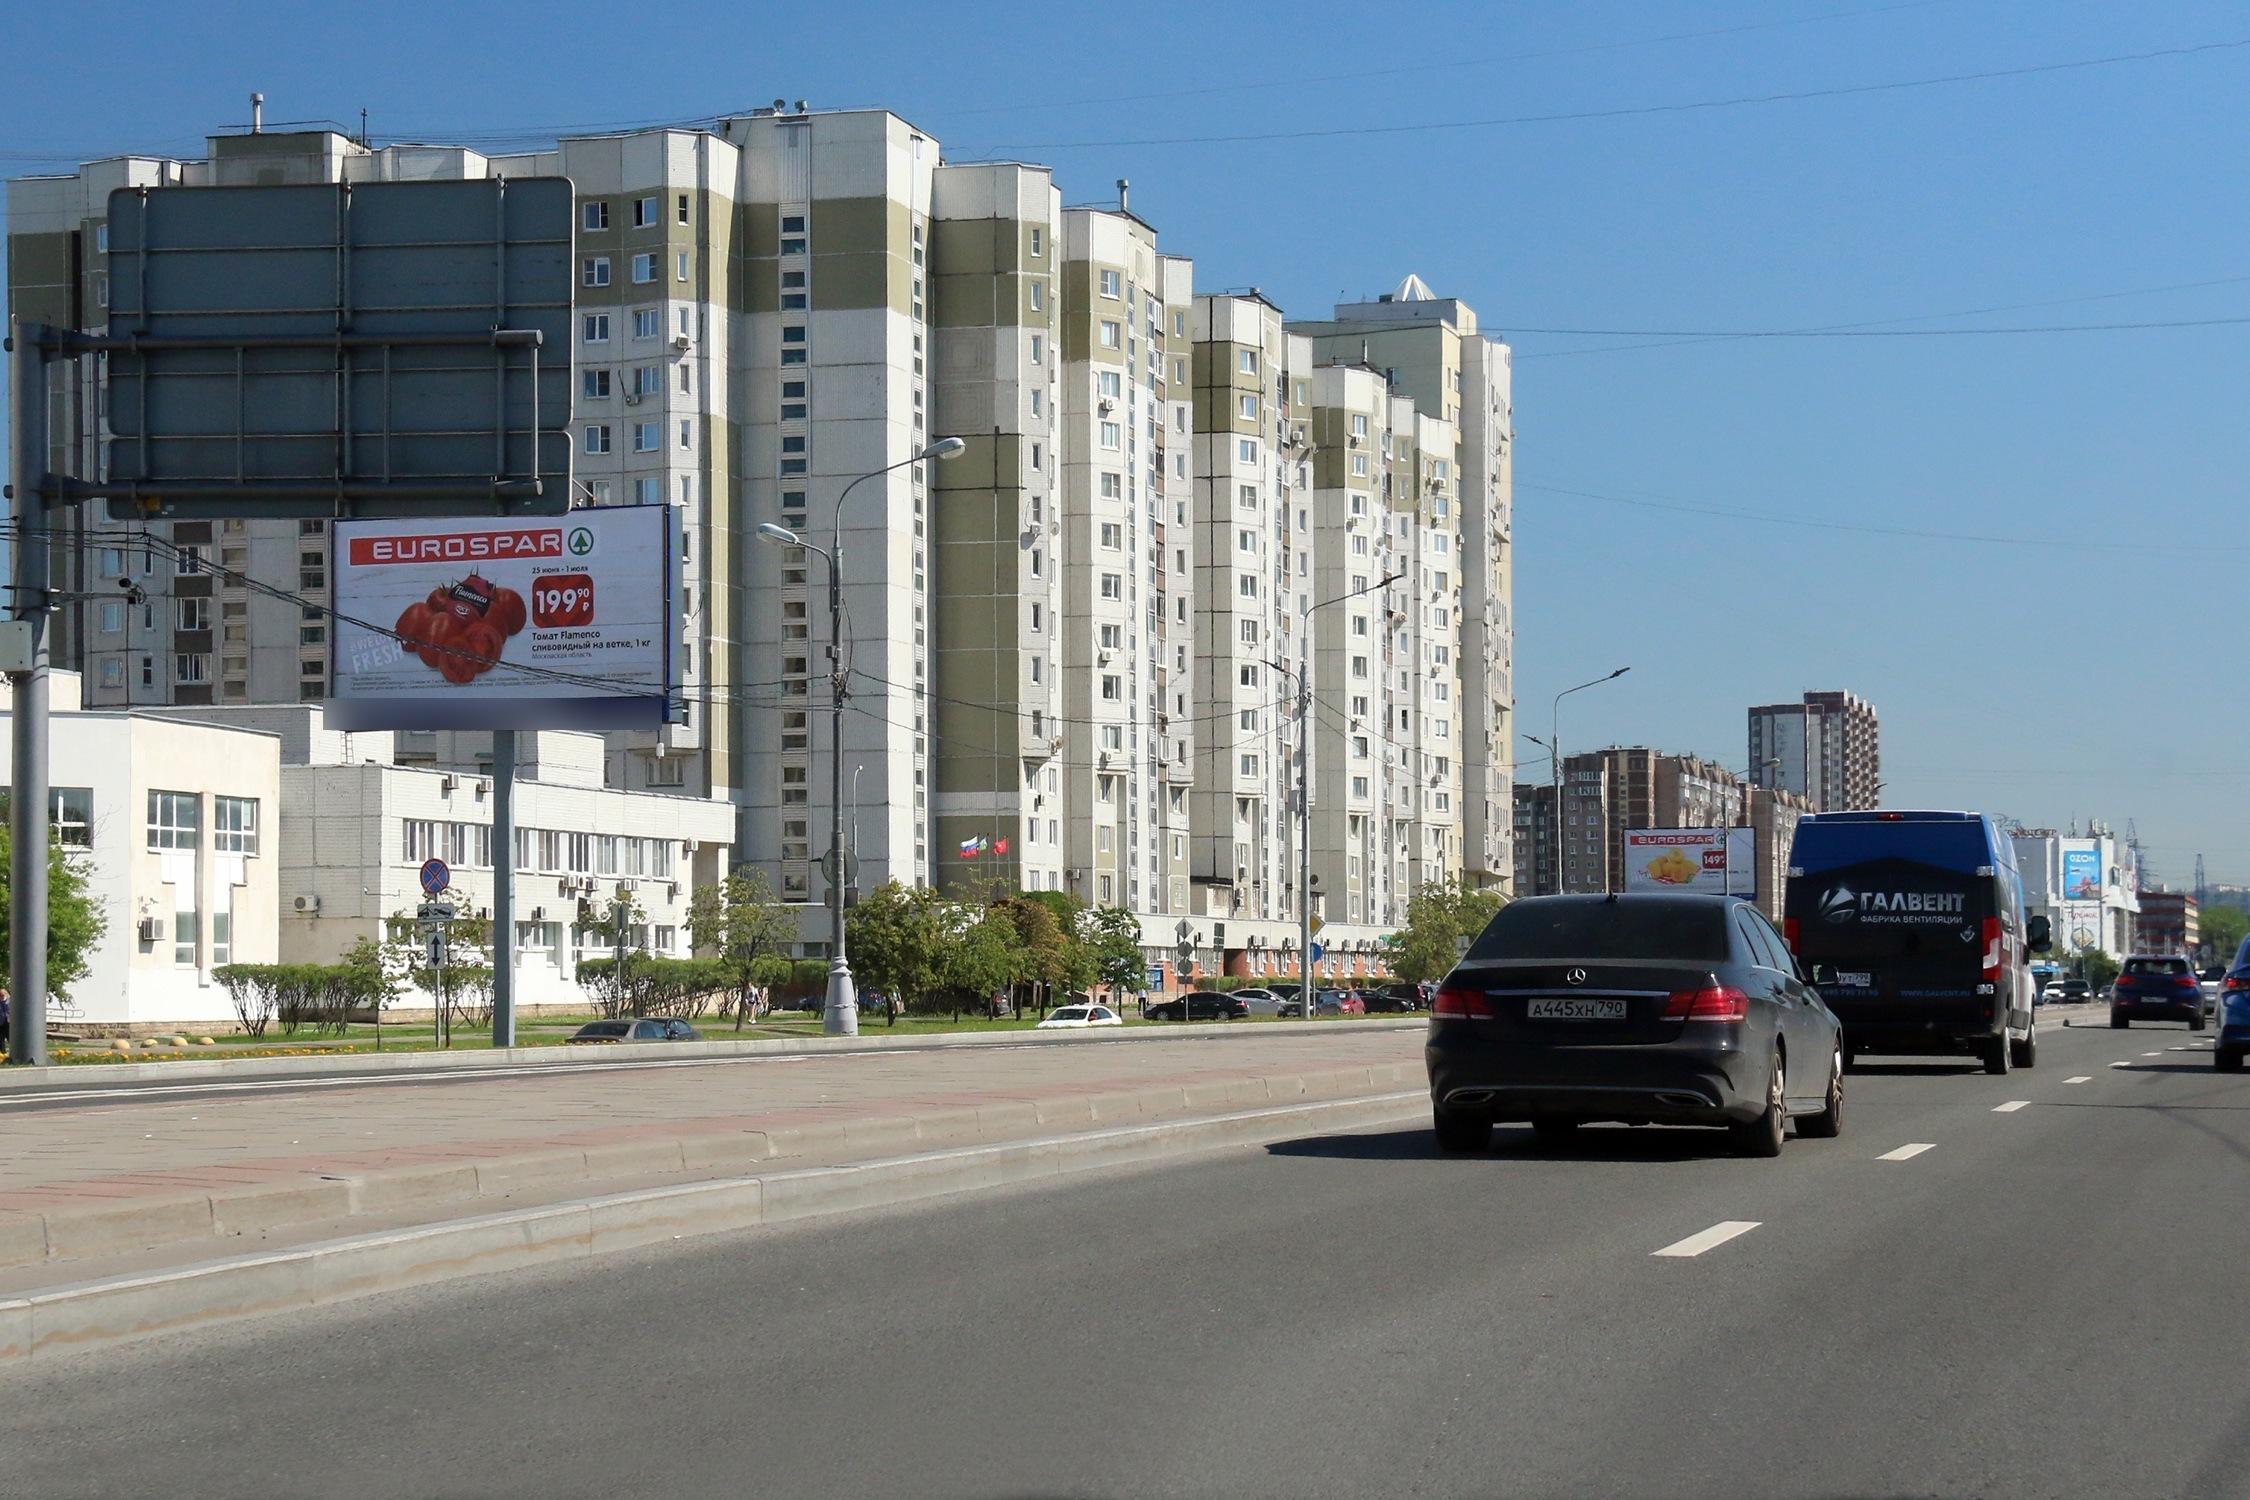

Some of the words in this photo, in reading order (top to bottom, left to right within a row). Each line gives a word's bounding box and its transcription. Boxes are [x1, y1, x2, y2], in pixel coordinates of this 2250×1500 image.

[372, 533, 561, 560] EUROSPAR
[454, 585, 488, 604] Flamenco
[536, 589, 577, 614] 199
[532, 632, 559, 641] Томат
[560, 631, 600, 640] Flamenco
[532, 641, 591, 652] сливовидный
[606, 640, 633, 649] ветке,
[636, 639, 640, 647] 1
[641, 639, 651, 647] кг
[352, 640, 404, 675] FRESH
[568, 651, 592, 659] область
[1638, 836, 1714, 844] EUROSPAR
[1703, 855, 1720, 865] 149
[1860, 892, 1965, 912] ГАЛВЕНТ
[1860, 915, 1900, 923] ФАБРИКА
[1903, 916, 1963, 924] ВЕНТИЛЯЦИИ
[1598, 1001, 1623, 1013] 790
